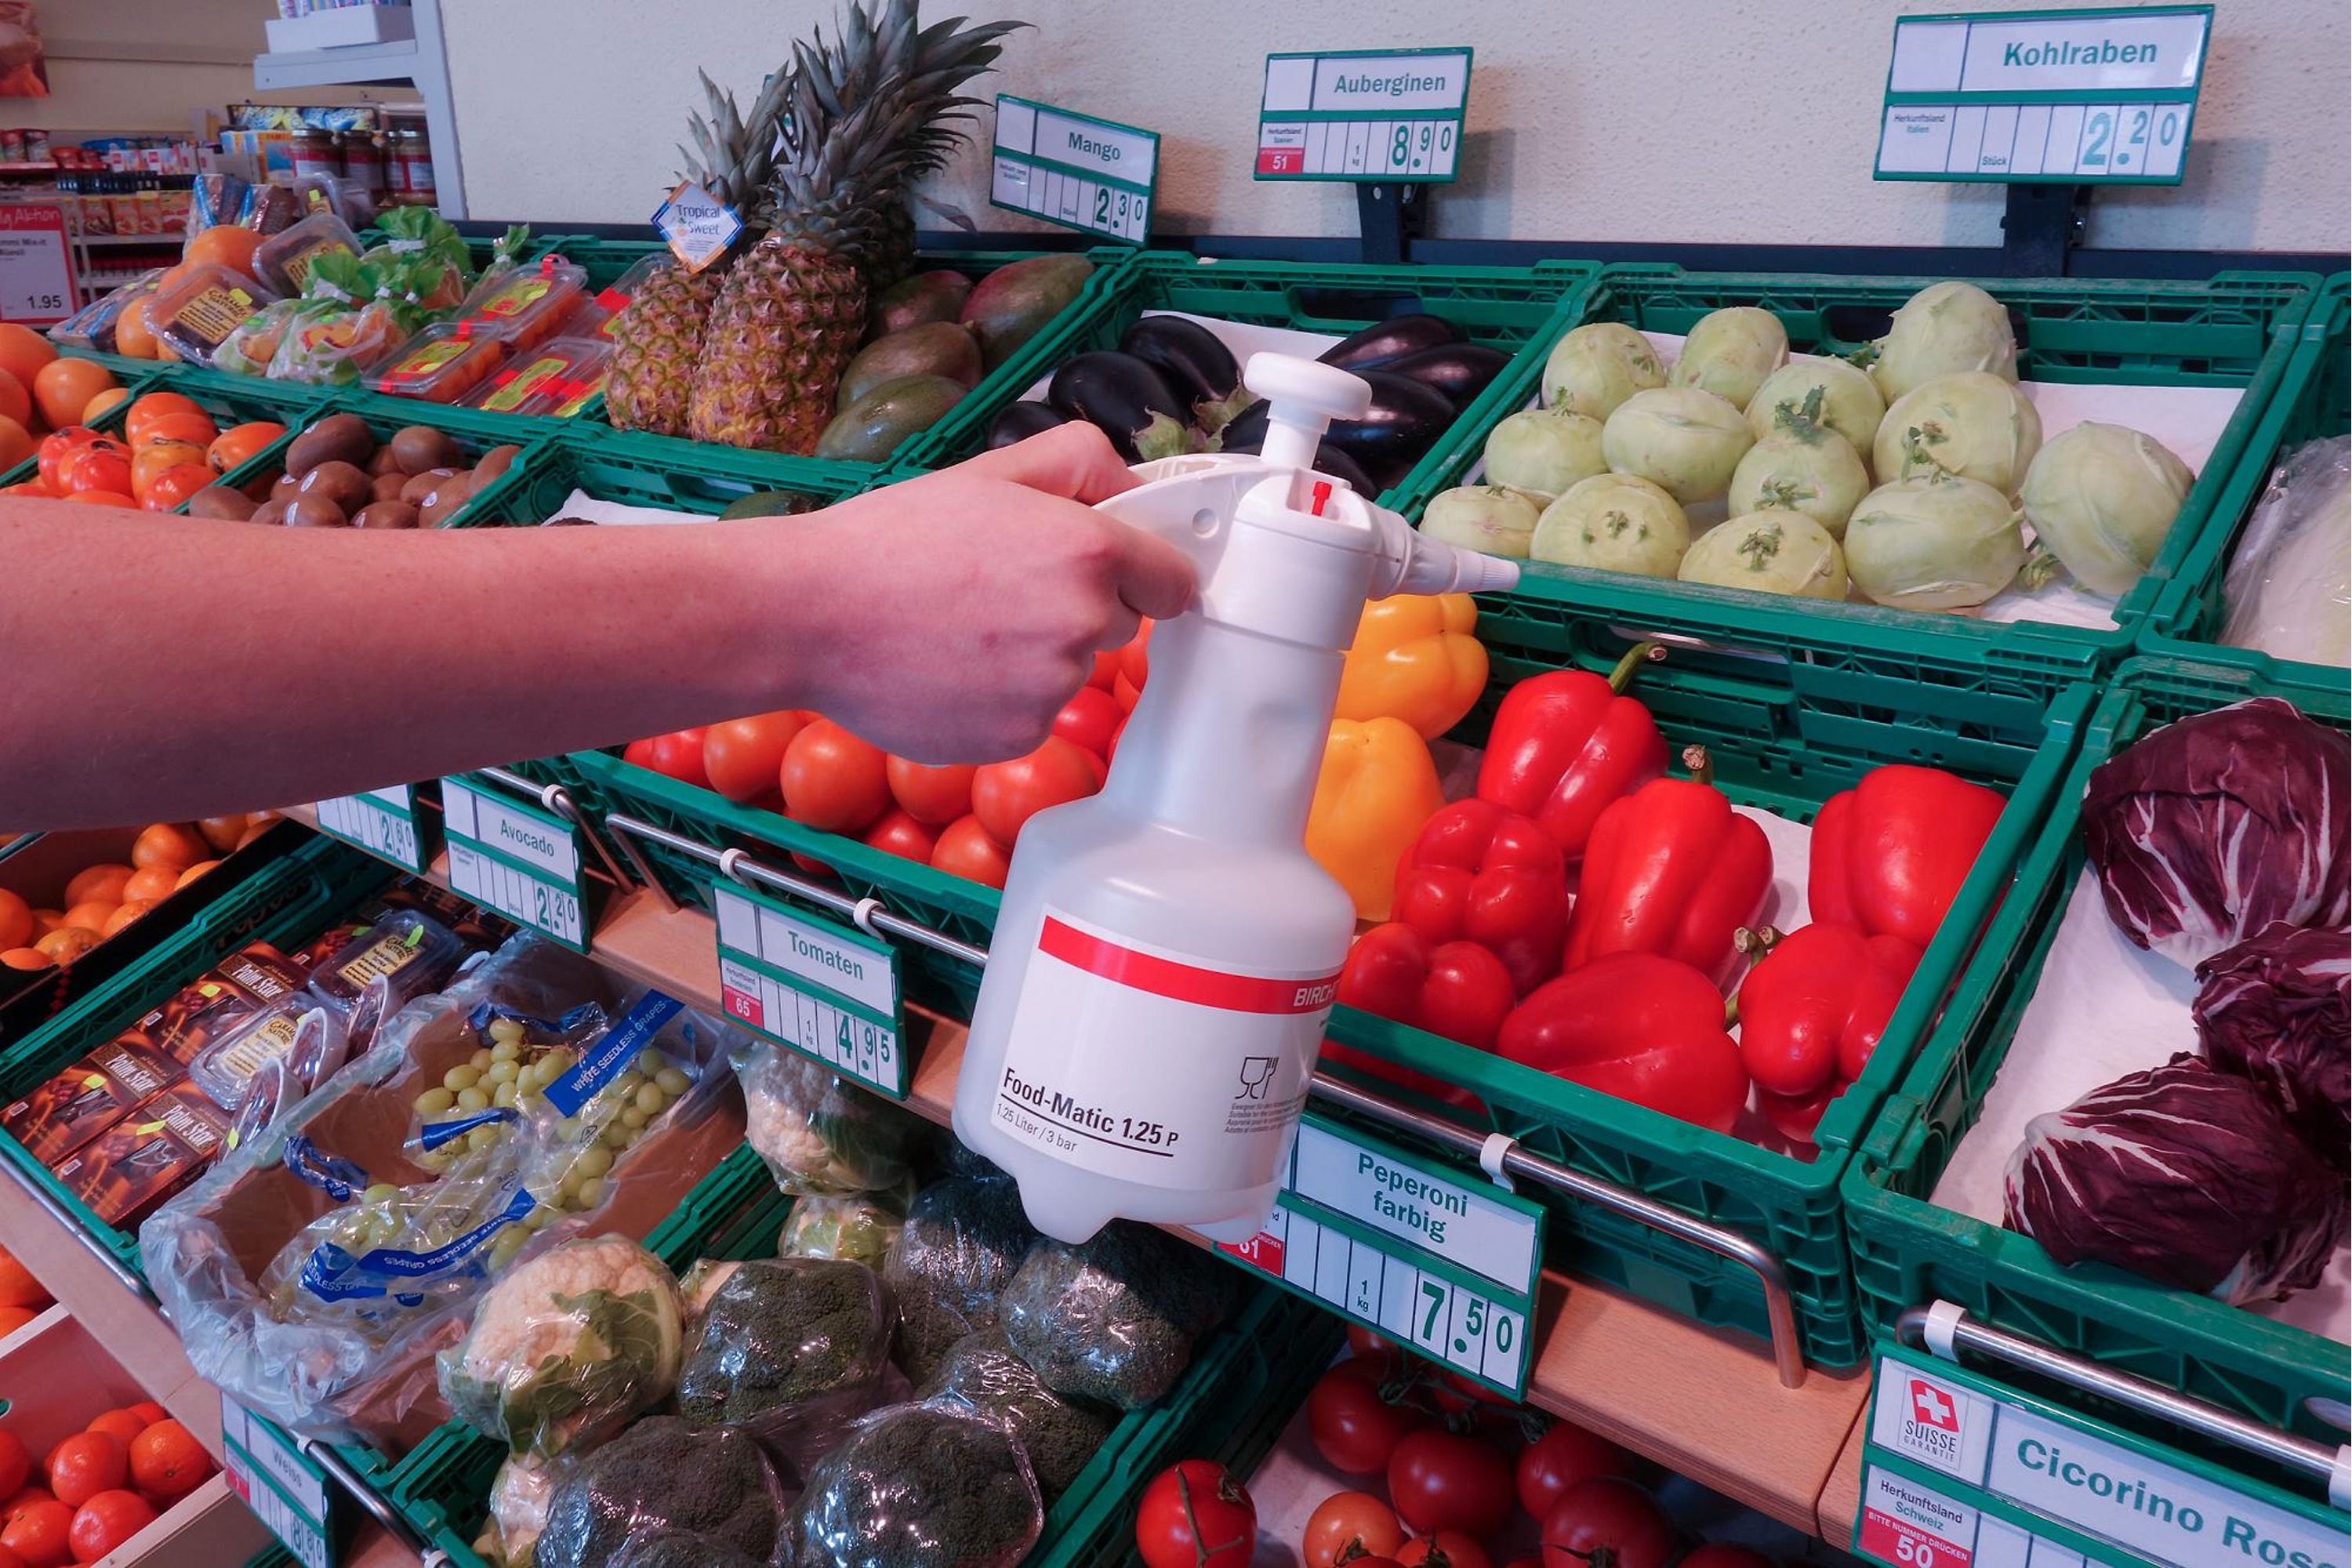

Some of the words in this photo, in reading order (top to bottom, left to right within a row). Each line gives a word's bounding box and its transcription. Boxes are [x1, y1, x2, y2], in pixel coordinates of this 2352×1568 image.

[2003, 39, 2158, 67] Kohlraben
[1334, 73, 1446, 96] Auberginen
[1068, 132, 1120, 162] Mango
[1392, 125, 1451, 168] 8.90
[2082, 111, 2177, 165] 2.20
[1272, 155, 1287, 170] 51
[1981, 155, 2007, 165] Stück
[676, 204, 720, 218] Tropical
[1095, 187, 1143, 228] 2.30
[688, 221, 720, 235] Sweet
[27, 295, 62, 309] 1.95
[500, 819, 554, 857] Avocado
[537, 887, 575, 931] 2.20
[788, 931, 863, 980] Tomaten
[231, 964, 263, 985] Palm
[252, 978, 284, 998] Star
[1294, 984, 1335, 1007] BIRCH
[736, 998, 750, 1017] 65
[806, 1020, 811, 1032] 1
[806, 1033, 813, 1045] kg
[571, 1065, 601, 1092] WHITE
[597, 1029, 637, 1069] SEEDLESS
[635, 1000, 666, 1032] GRAPES
[838, 1015, 890, 1070] 4.95
[105, 1054, 137, 1078] Palm
[125, 1070, 157, 1092] Star
[1004, 1067, 1114, 1133] Food-Matic
[1122, 1117, 1163, 1145] 1.25
[1166, 1132, 1179, 1147] P
[160, 1104, 194, 1131] Palm
[183, 1122, 216, 1146] Star
[996, 1103, 1014, 1123] 1.25
[1015, 1112, 1039, 1136] Liter
[1046, 1130, 1054, 1143] 3
[1056, 1134, 1077, 1152] bar
[1358, 1152, 1468, 1217] Peperoni
[1374, 1190, 1447, 1243] farbig
[383, 1257, 426, 1269] GRAPES
[427, 1235, 478, 1265] SEEDLESS
[307, 1258, 342, 1291] EEDLESS
[1361, 1279, 1368, 1294] 1
[1357, 1296, 1370, 1312] kg
[1423, 1280, 1513, 1354] 7.50
[1904, 1436, 1955, 1462] GARANTIE
[1905, 1421, 1956, 1453] SUISSE
[1880, 1479, 1962, 1524] Herkunftsland
[1895, 1501, 1945, 1530] Schweiz
[2017, 1438, 2204, 1533] Cicorino
[2222, 1515, 2337, 1568] Ros
[1868, 1511, 1891, 1527] BITTE
[1892, 1523, 1927, 1542] NUMMER
[1896, 1534, 1933, 1568] 50
